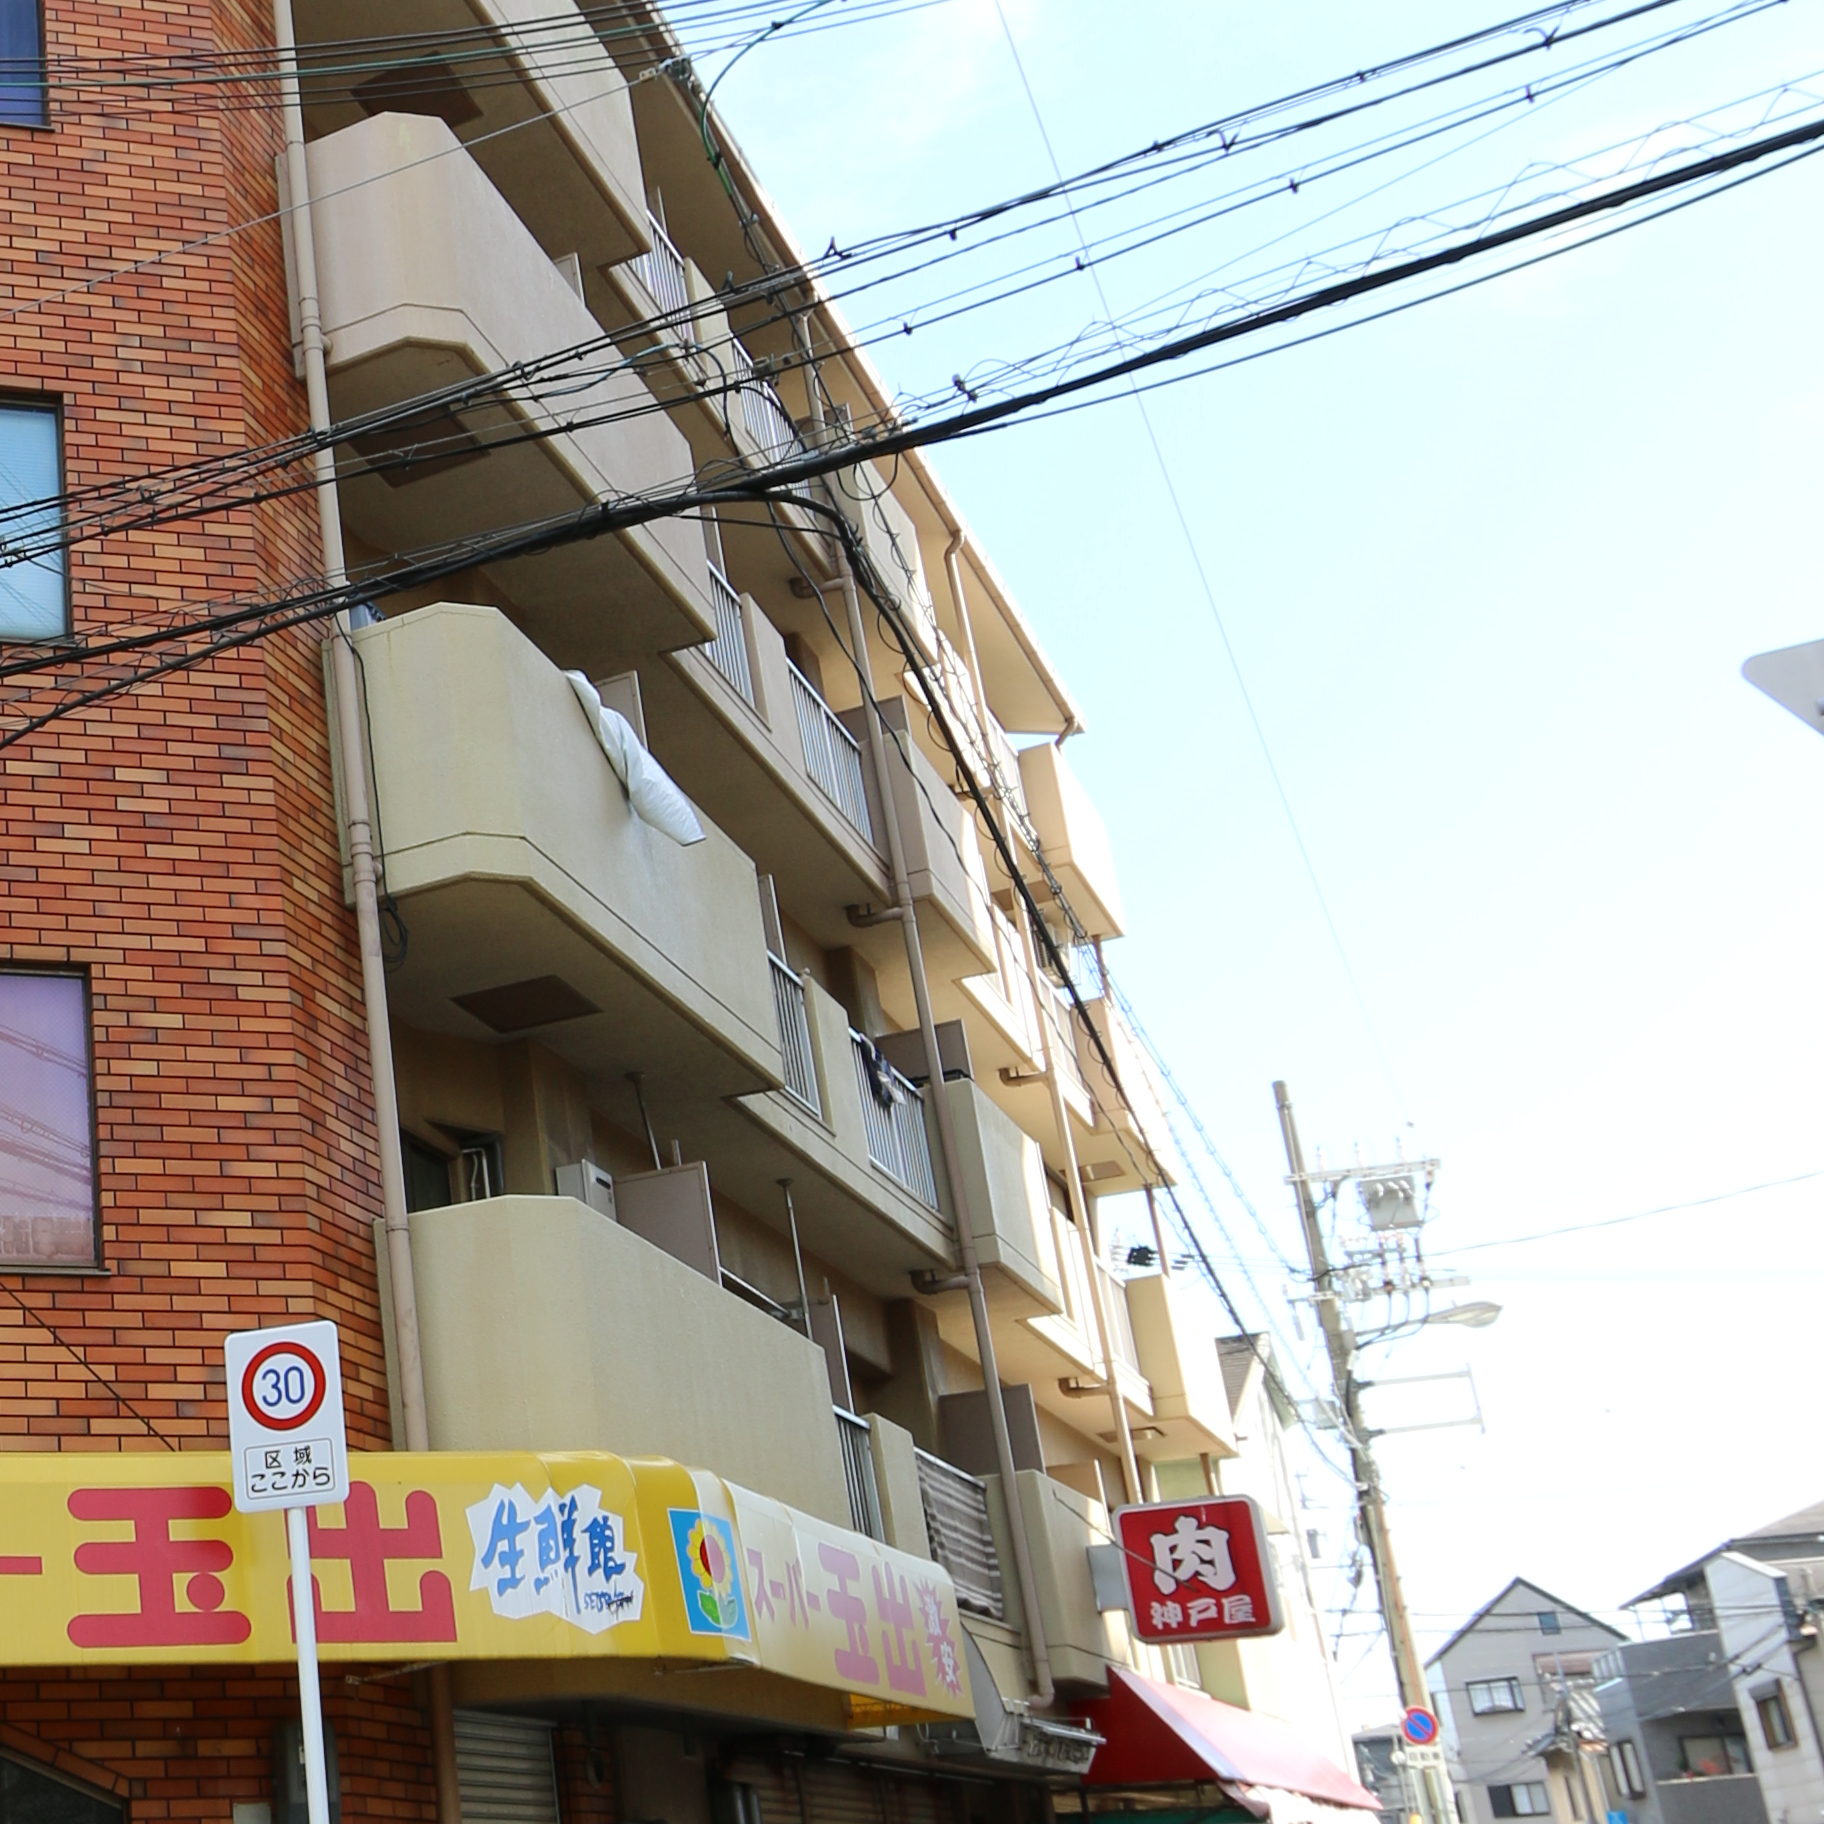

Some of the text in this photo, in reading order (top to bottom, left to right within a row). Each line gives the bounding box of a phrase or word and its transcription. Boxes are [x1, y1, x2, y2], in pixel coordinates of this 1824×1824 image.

[261, 1365, 306, 1408] 30
[264, 1444, 313, 1470] 区域
[250, 1465, 331, 1494] ここから
[480, 1494, 627, 1615] 生鮮館
[1149, 1514, 1237, 1596] 肉
[745, 1541, 927, 1697] スーパー玉出
[1148, 1594, 1257, 1631] 神戸屋
